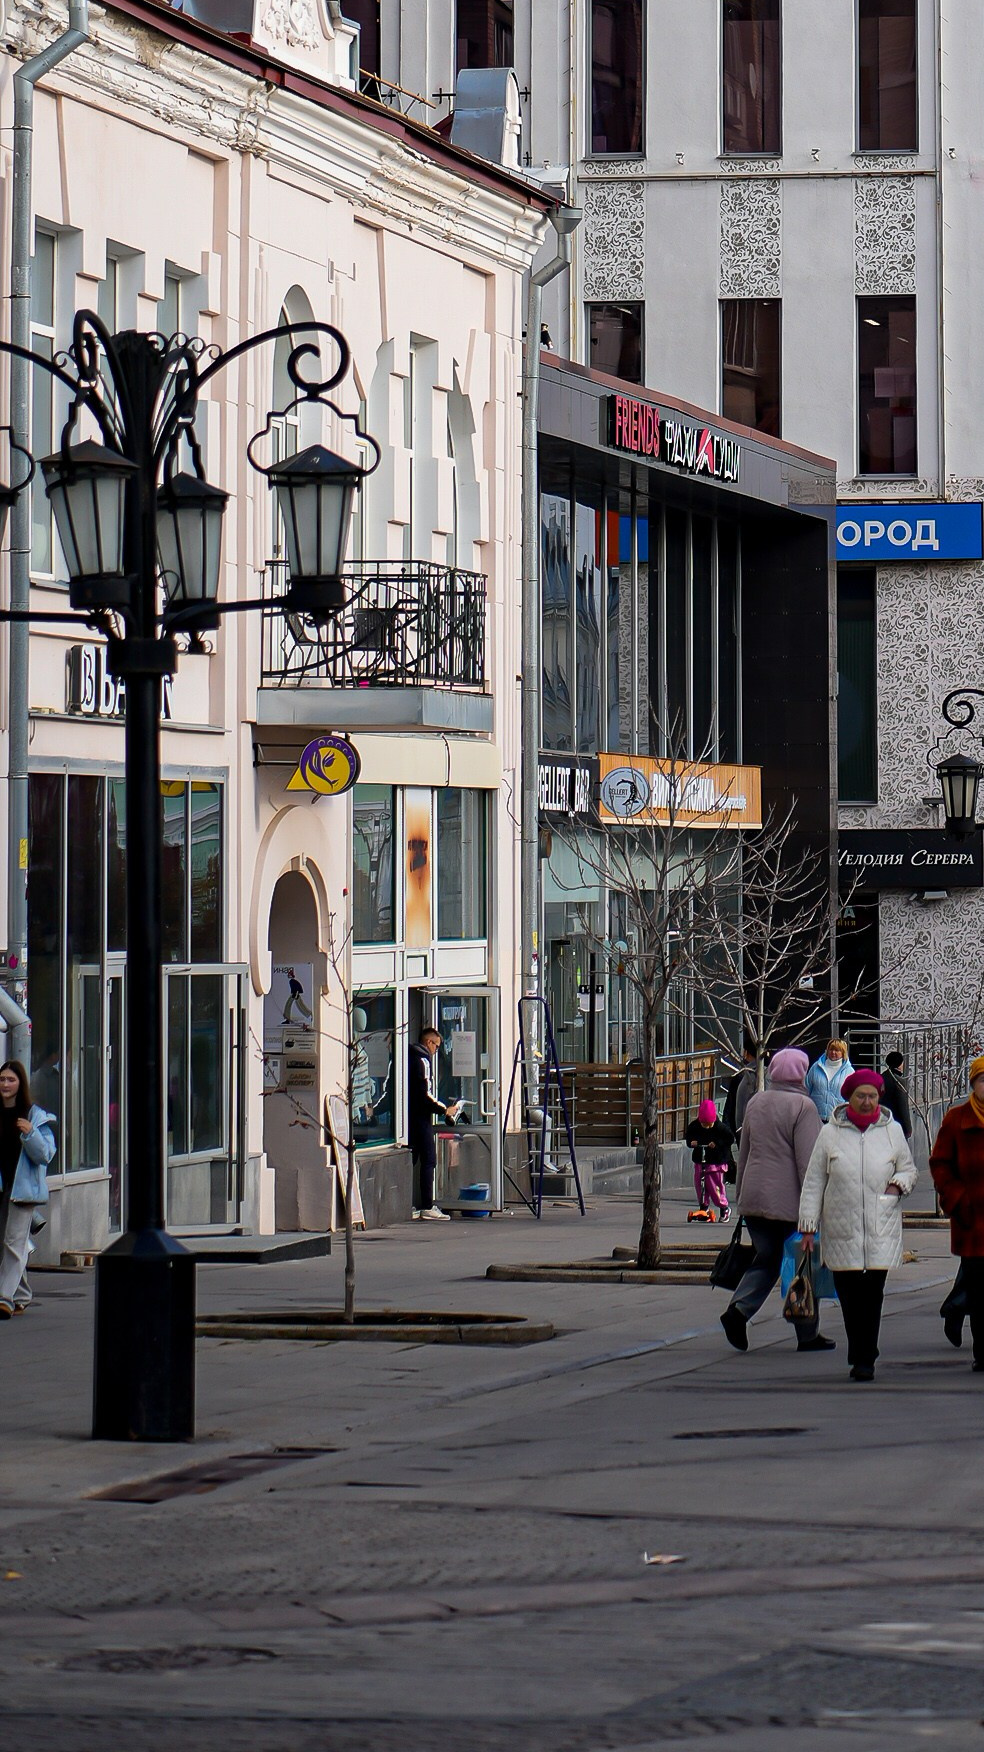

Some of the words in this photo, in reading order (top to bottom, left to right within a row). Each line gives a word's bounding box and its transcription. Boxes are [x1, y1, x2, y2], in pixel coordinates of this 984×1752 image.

[615, 394, 660, 458] FRIENDS
[836, 519, 940, 551] ОРОД
[539, 764, 571, 812] GELLERT
[574, 768, 590, 813] BAR
